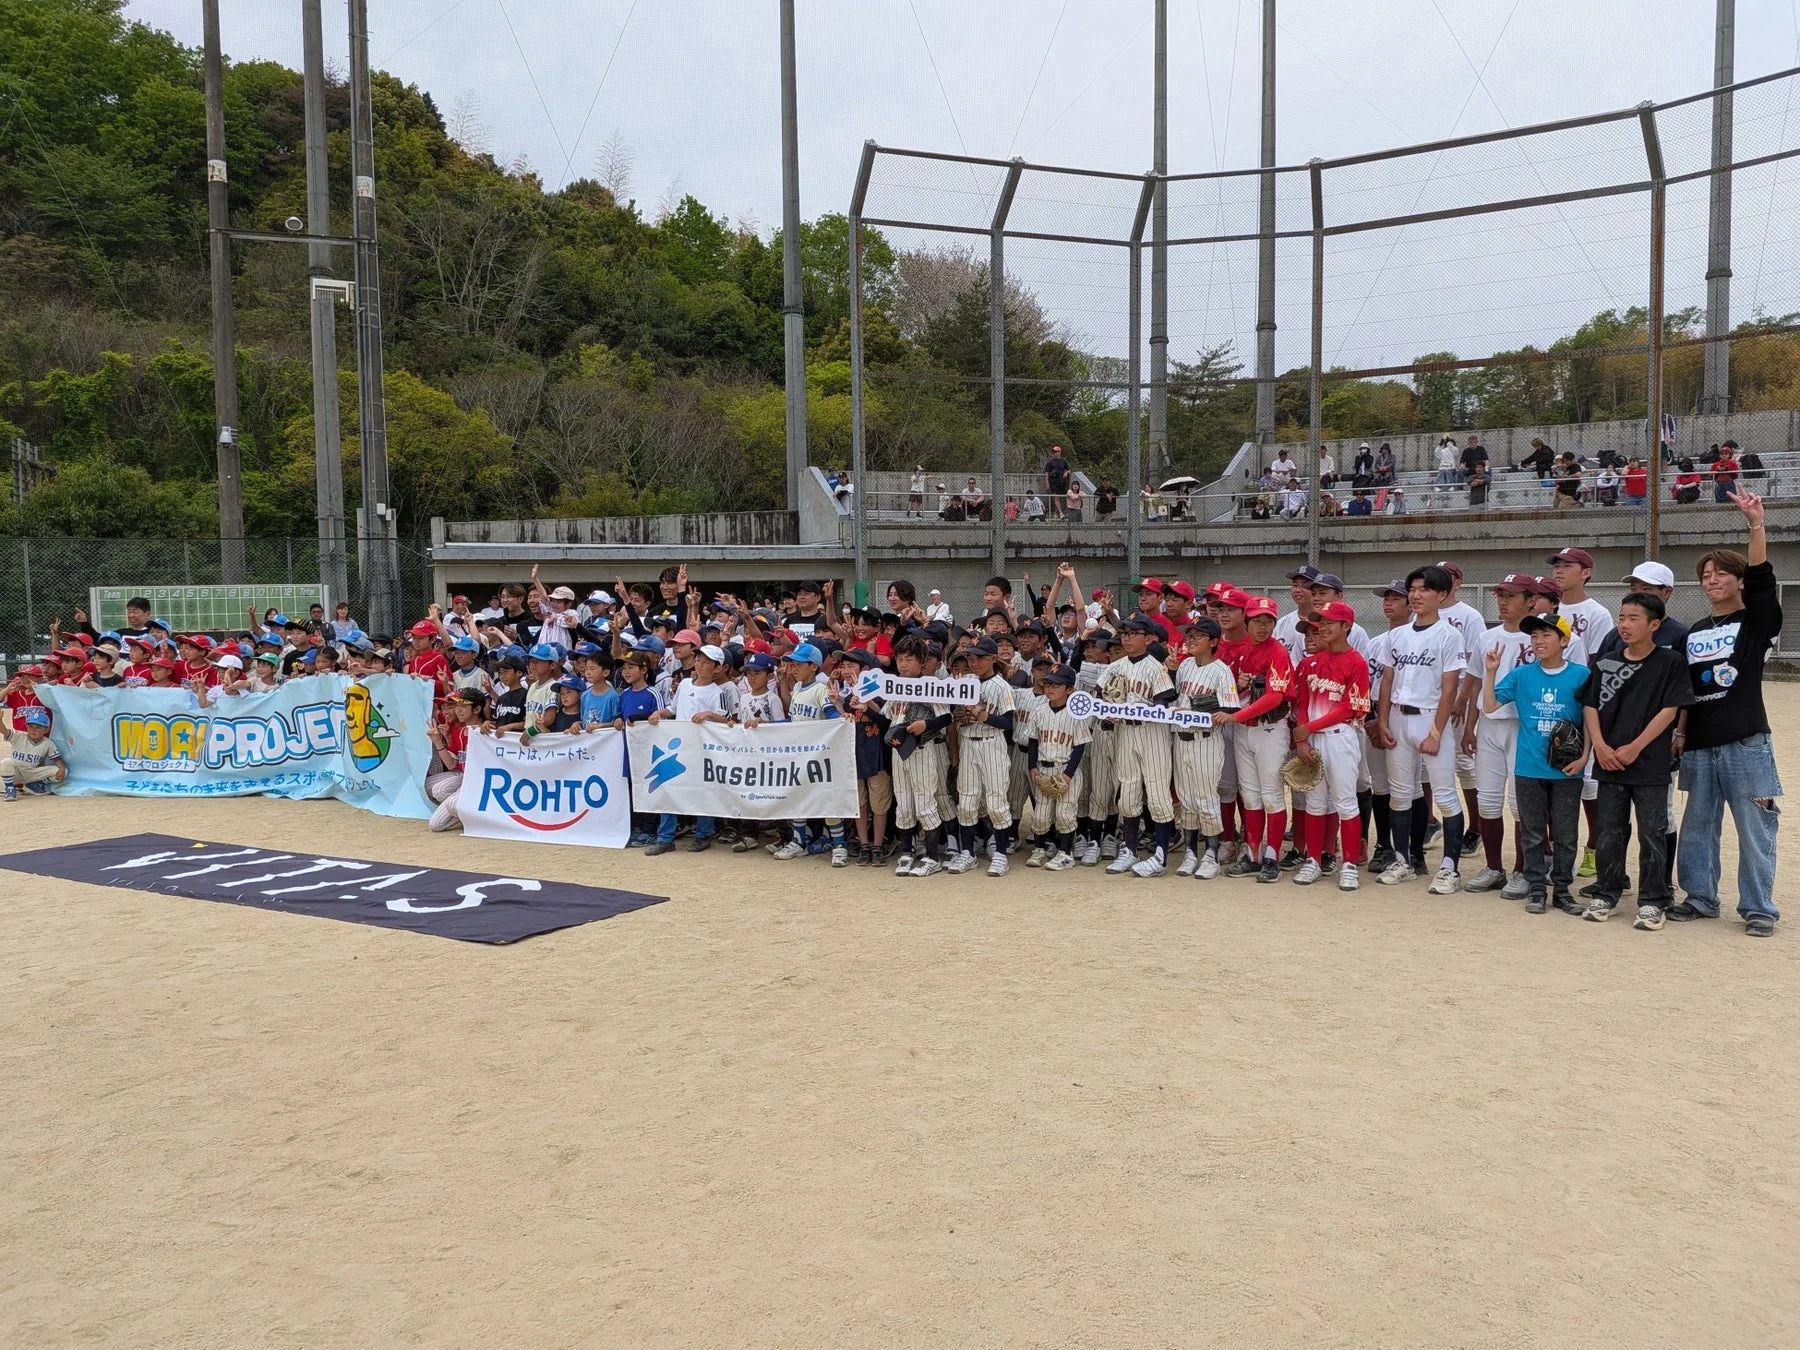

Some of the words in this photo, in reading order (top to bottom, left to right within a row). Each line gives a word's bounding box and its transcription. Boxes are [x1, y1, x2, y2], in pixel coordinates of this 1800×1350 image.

[103, 590, 122, 599] Team
[130, 590, 137, 599] 1
[143, 590, 152, 598] 2
[157, 590, 166, 598] 3
[172, 590, 180, 598] 4
[186, 590, 195, 598] 5
[201, 589, 209, 598] 6
[215, 589, 222, 598] 7
[228, 589, 237, 597] 8
[243, 589, 250, 597] 9
[256, 588, 266, 597] 10
[270, 588, 278, 597] 11
[283, 588, 293, 597] 12
[299, 588, 316, 597] Total
[885, 679, 955, 698] Baselink
[959, 684, 974, 699] AI
[1092, 701, 1166, 720] SportsTech
[1168, 711, 1210, 726] Japan
[495, 746, 596, 762] ロートは、ハートだ。
[703, 757, 802, 787] Baselink
[806, 757, 832, 784] AI
[477, 767, 609, 813] ROHTO
